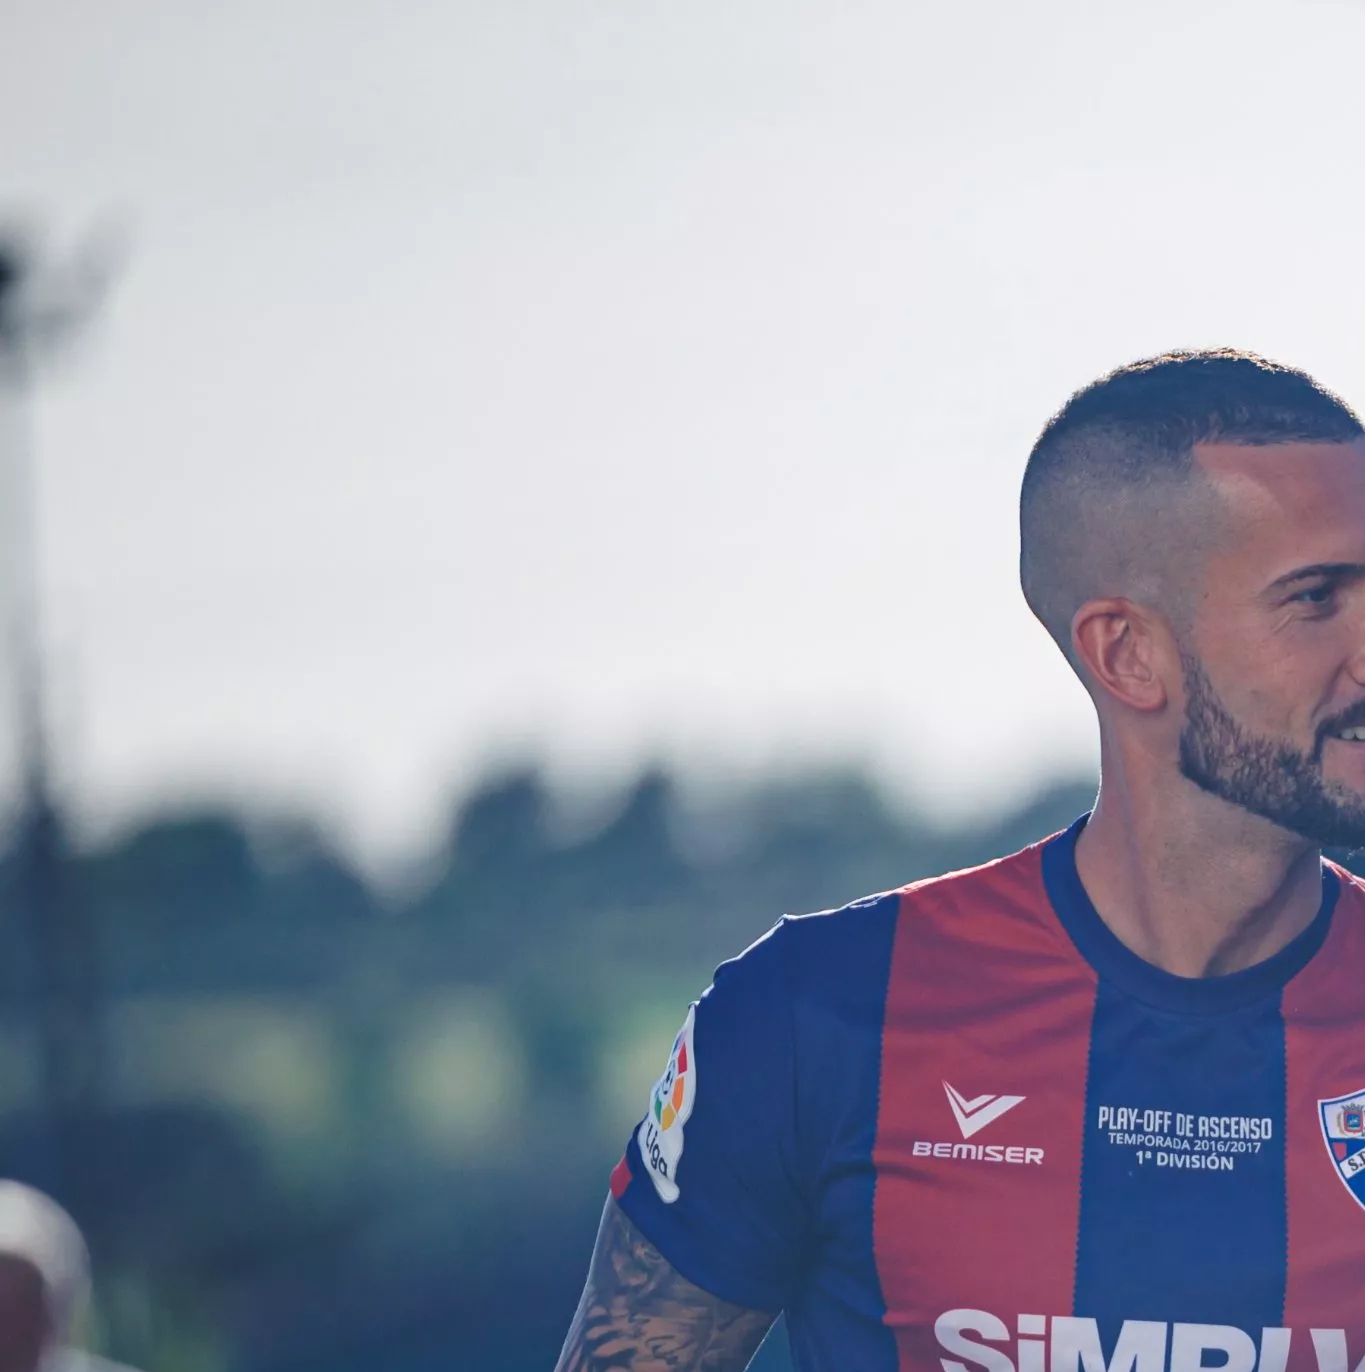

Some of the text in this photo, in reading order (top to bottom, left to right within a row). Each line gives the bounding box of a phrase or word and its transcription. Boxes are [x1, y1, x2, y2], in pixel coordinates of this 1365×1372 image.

[1098, 1106, 1273, 1140] PLAY-OFF DE ASCENSO
[912, 1141, 1045, 1165] BEMISER
[1108, 1132, 1261, 1154] TEMPORADA 2016/2017
[1156, 1152, 1235, 1171] DIVISIÓN
